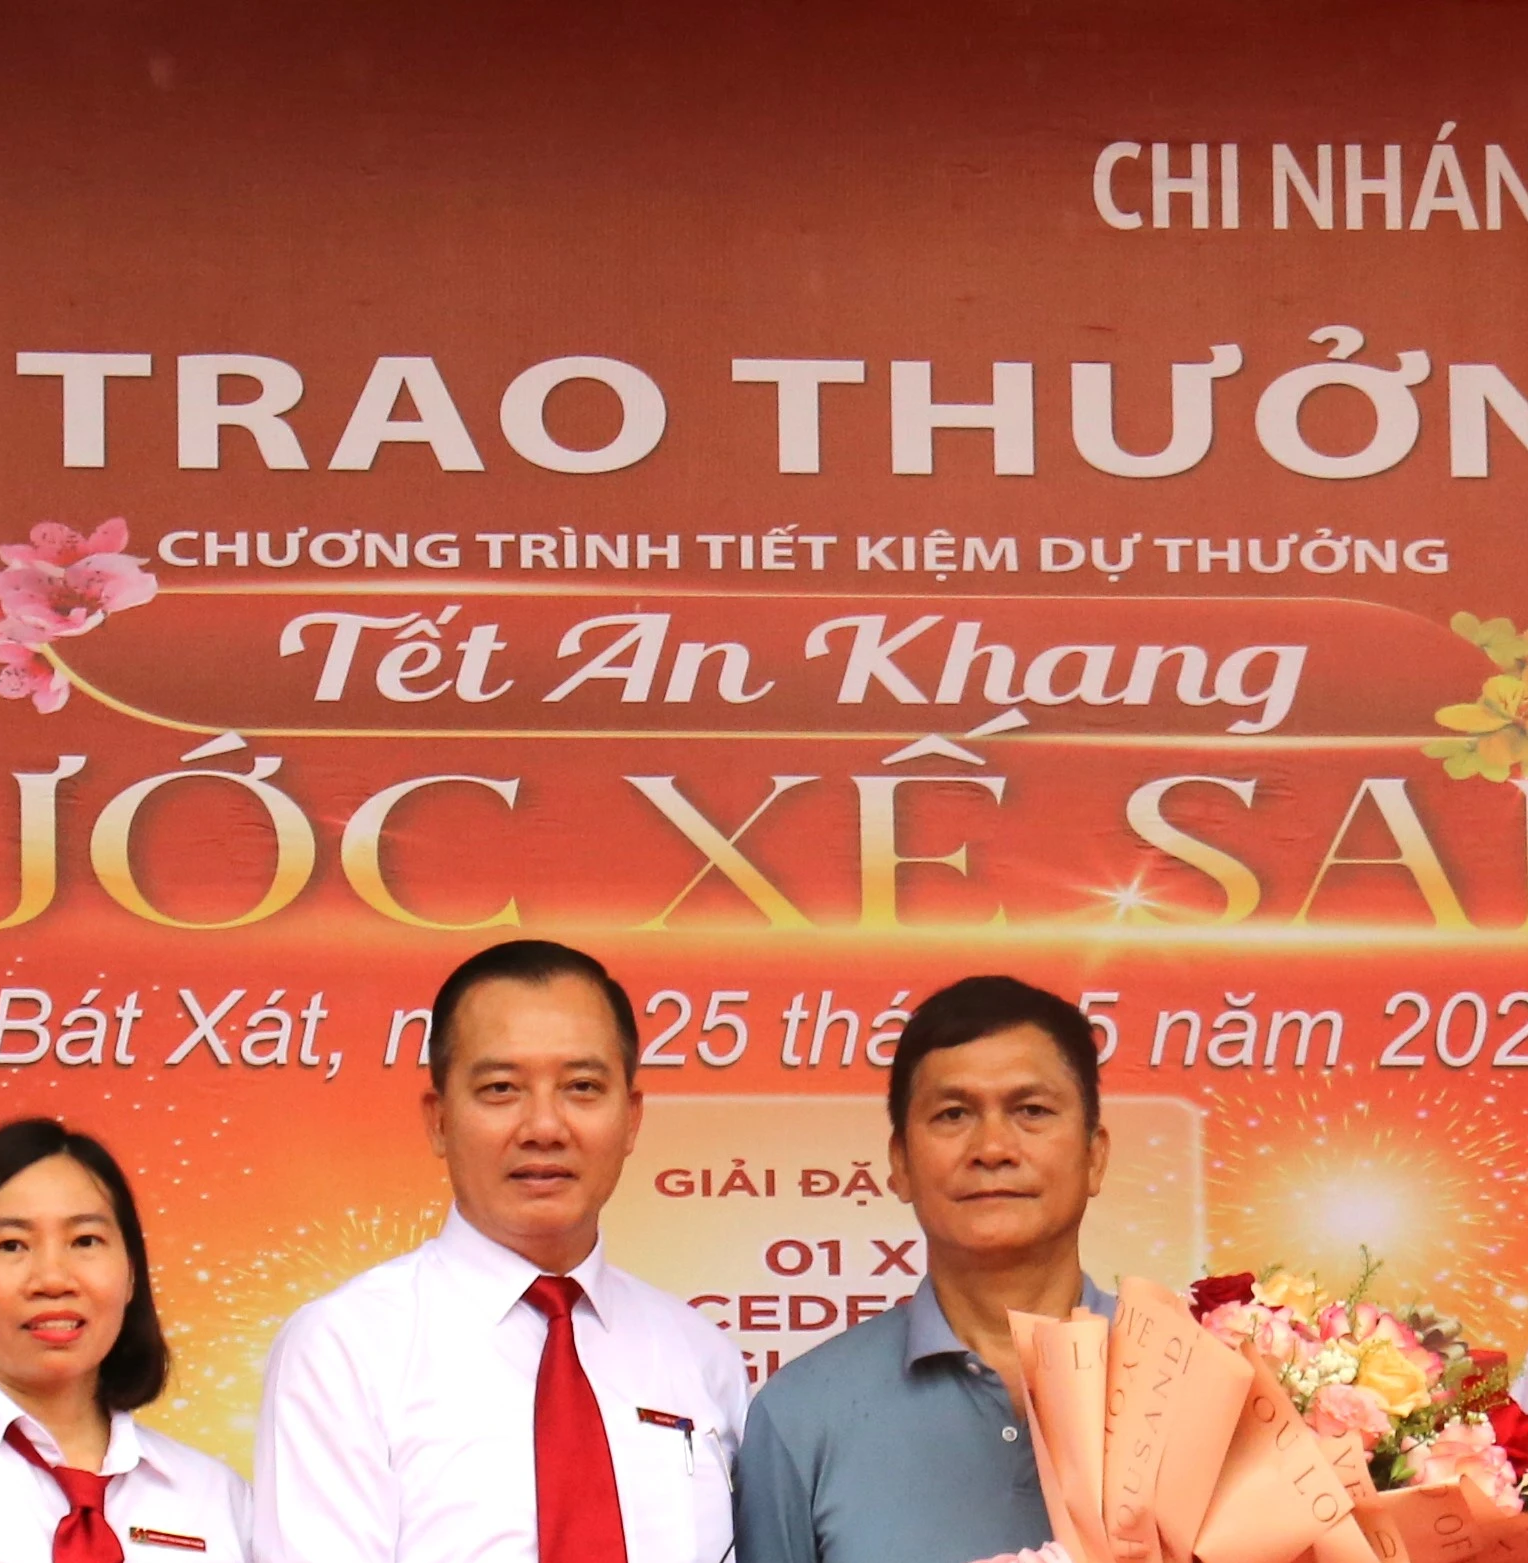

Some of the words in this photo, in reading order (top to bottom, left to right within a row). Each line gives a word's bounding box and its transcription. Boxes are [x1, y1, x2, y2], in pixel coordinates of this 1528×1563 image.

[1093, 141, 1239, 231] CHI
[16, 351, 667, 475] TRAO
[157, 526, 462, 570] CHƯƠNG
[475, 526, 681, 570] TRÌNH
[695, 523, 838, 571] TIẾT
[856, 528, 1019, 583] KIỆM
[1039, 531, 1144, 583] DỰ
[1153, 527, 1450, 575] THƯỞNG
[278, 603, 515, 704] Tết
[540, 610, 776, 704] An
[804, 613, 1309, 735] Khang
[622, 708, 1008, 933] XẾ
[164, 987, 343, 1080] Xát,
[639, 989, 750, 1068] 25
[780, 989, 915, 1068] thá
[1078, 991, 1120, 1067] 5
[1148, 991, 1344, 1068] năm
[654, 1158, 777, 1199] GIẢI
[798, 1160, 897, 1206] ĐẶ
[765, 1239, 841, 1277] 01
[870, 1239, 920, 1277] X
